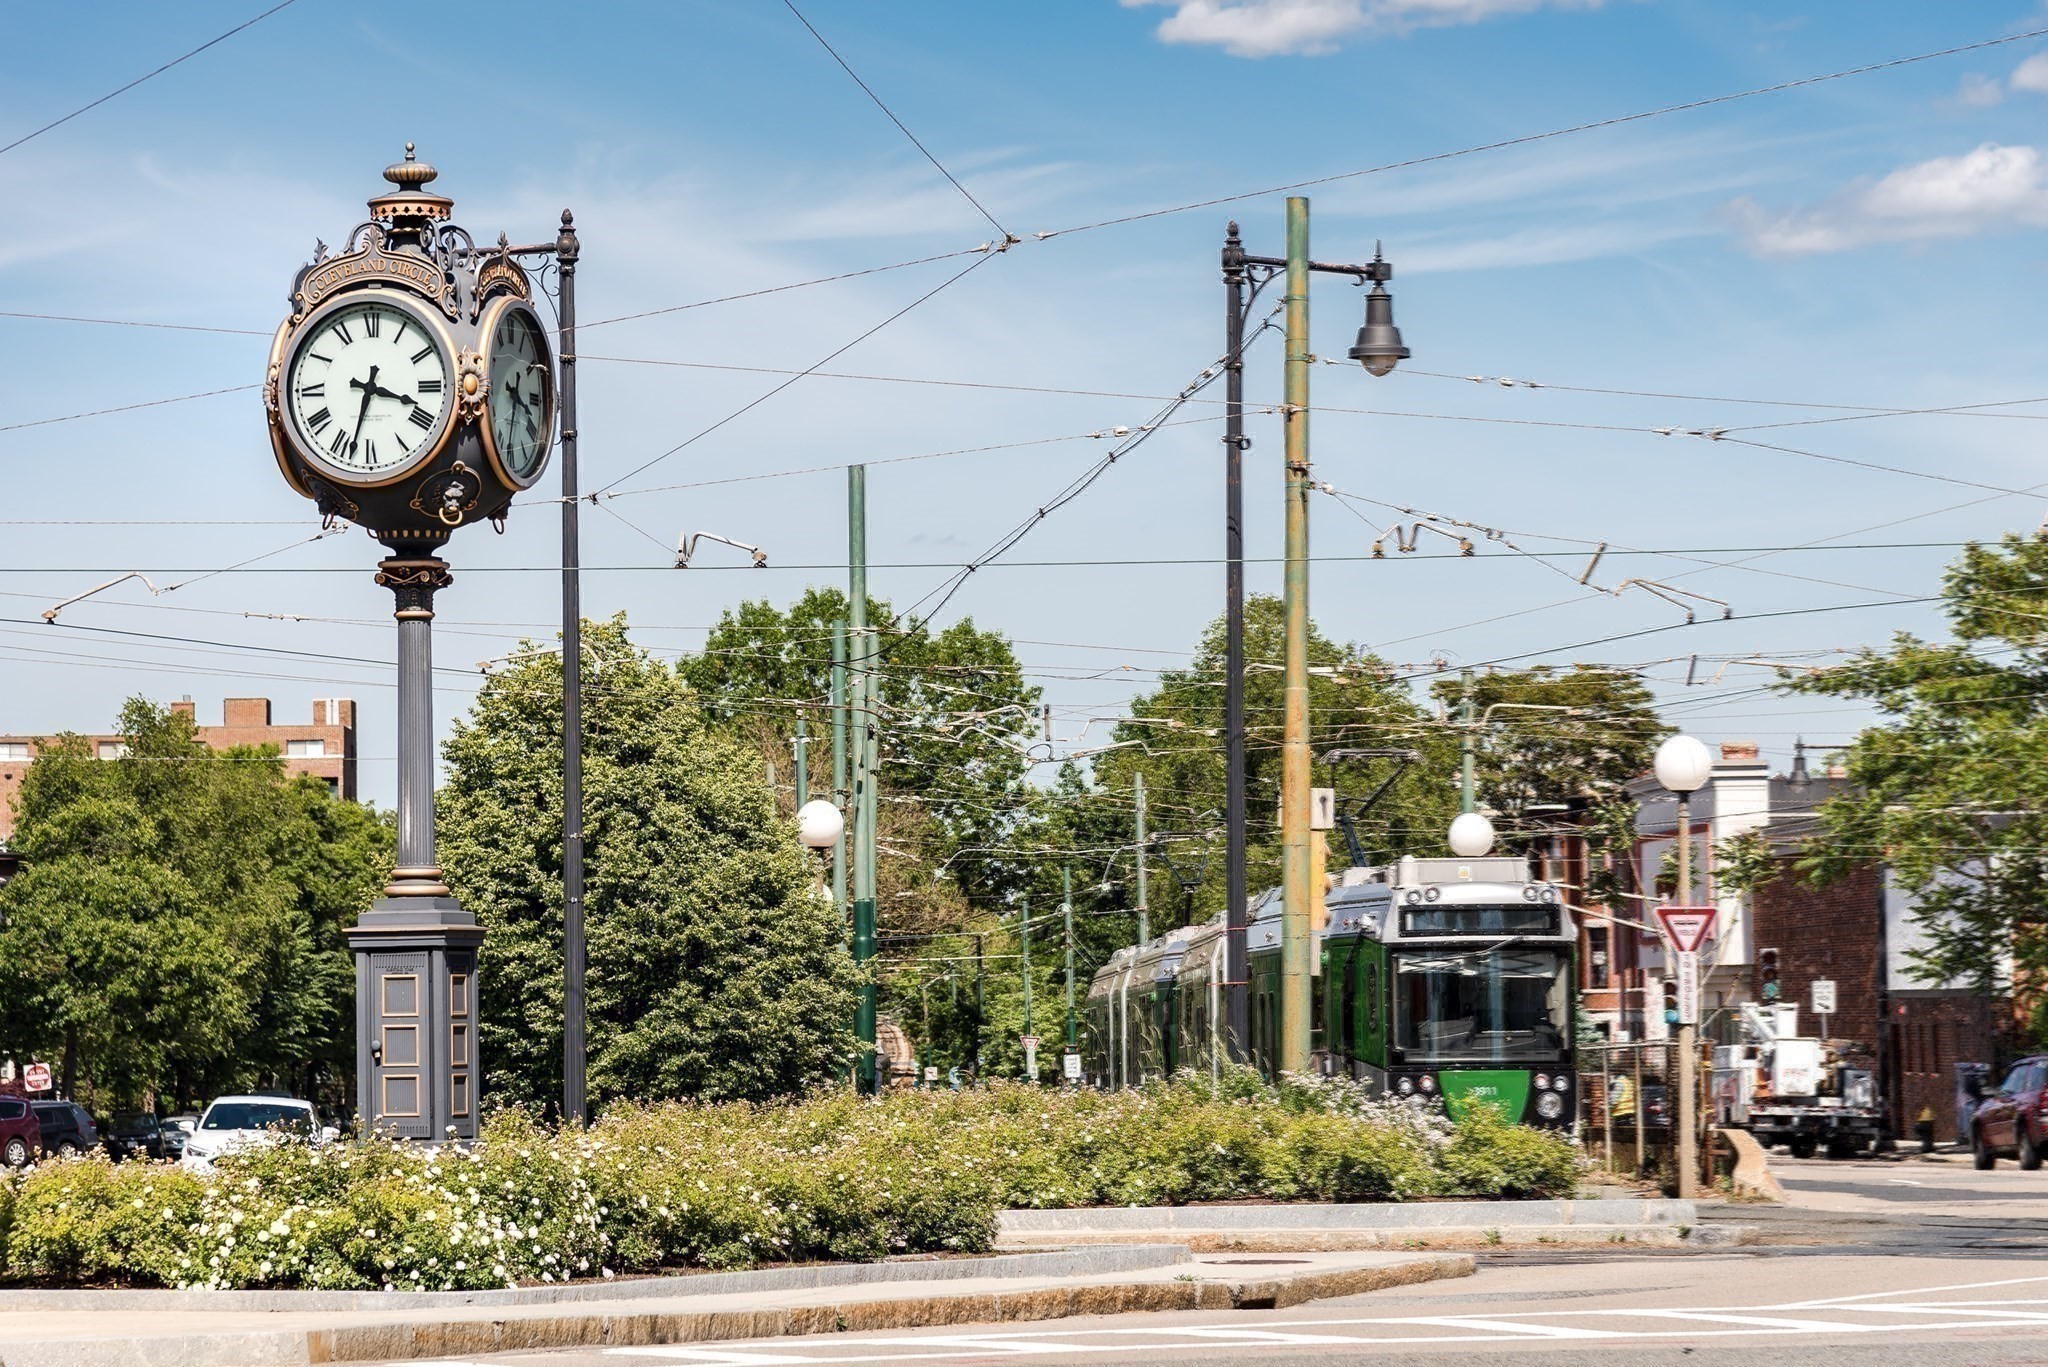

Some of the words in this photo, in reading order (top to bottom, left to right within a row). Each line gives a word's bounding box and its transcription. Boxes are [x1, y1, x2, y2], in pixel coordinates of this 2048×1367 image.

[315, 259, 386, 290] CLEVELAND
[389, 259, 433, 285] CIRCLE
[363, 313, 381, 338] XII
[410, 345, 434, 365] II
[418, 379, 442, 393] III
